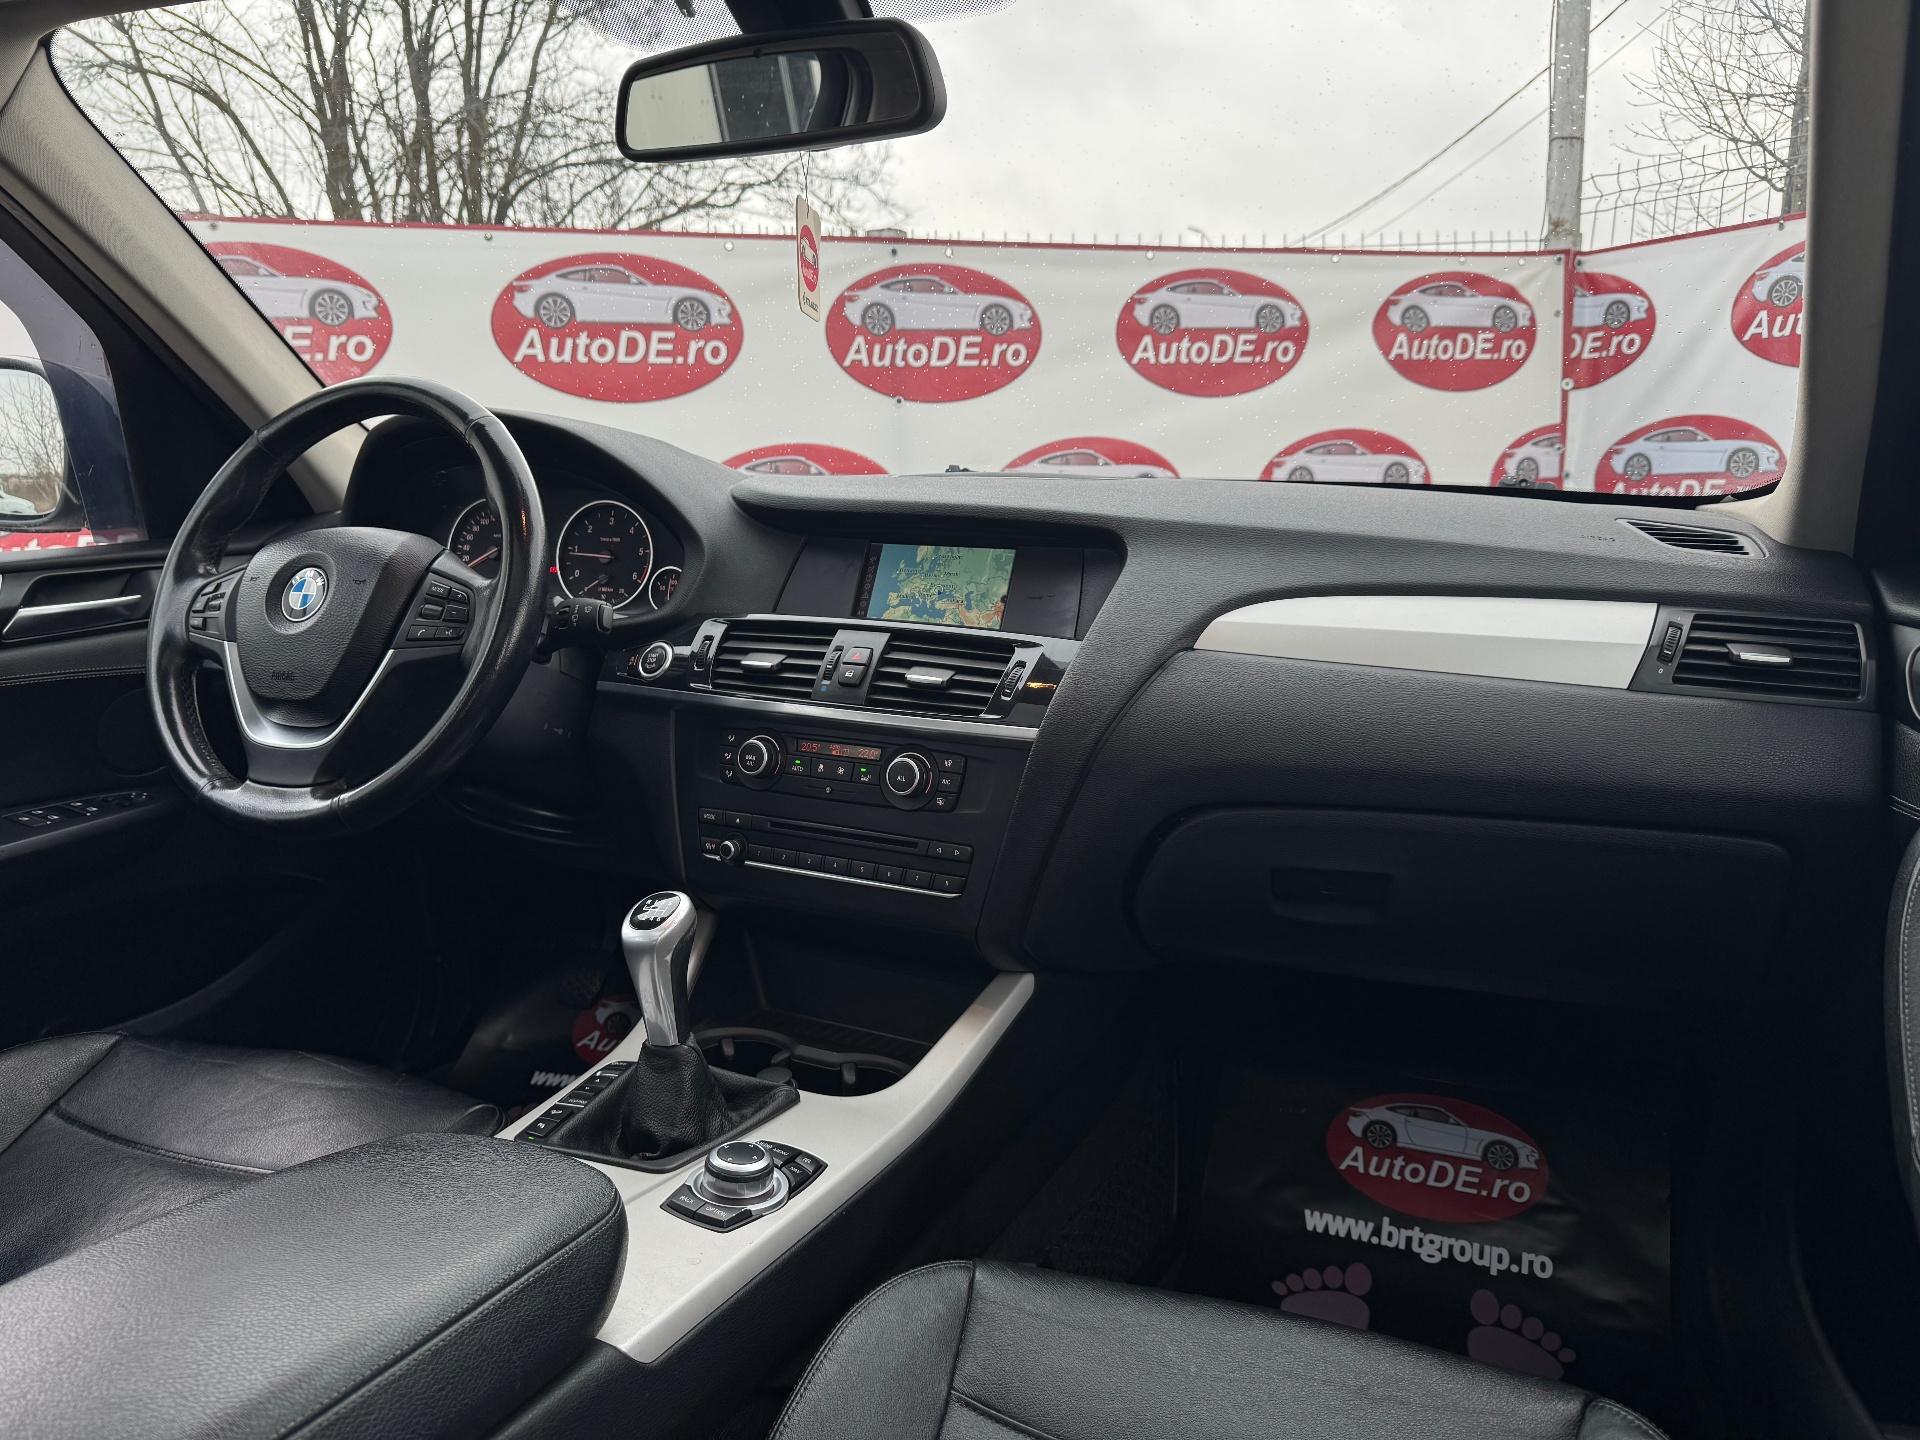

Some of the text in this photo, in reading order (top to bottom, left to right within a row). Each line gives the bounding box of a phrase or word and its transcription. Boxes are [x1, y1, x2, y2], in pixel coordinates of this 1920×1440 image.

[513, 328, 728, 366] AutoDE.ro
[843, 335, 1028, 368] AutoDE.ro
[1131, 334, 1296, 364] AutoDE.ro
[1388, 333, 1527, 361] AutoDE.ro
[609, 517, 615, 525] 3
[574, 545, 578, 553] 1
[639, 548, 644, 556] 5
[574, 569, 580, 577] 0
[632, 572, 637, 580] 6
[1338, 1145, 1532, 1204] AutoDE.ro
[705, 1205, 728, 1218] OPTION
[1303, 1207, 1554, 1279] www.brtgroup.ro
